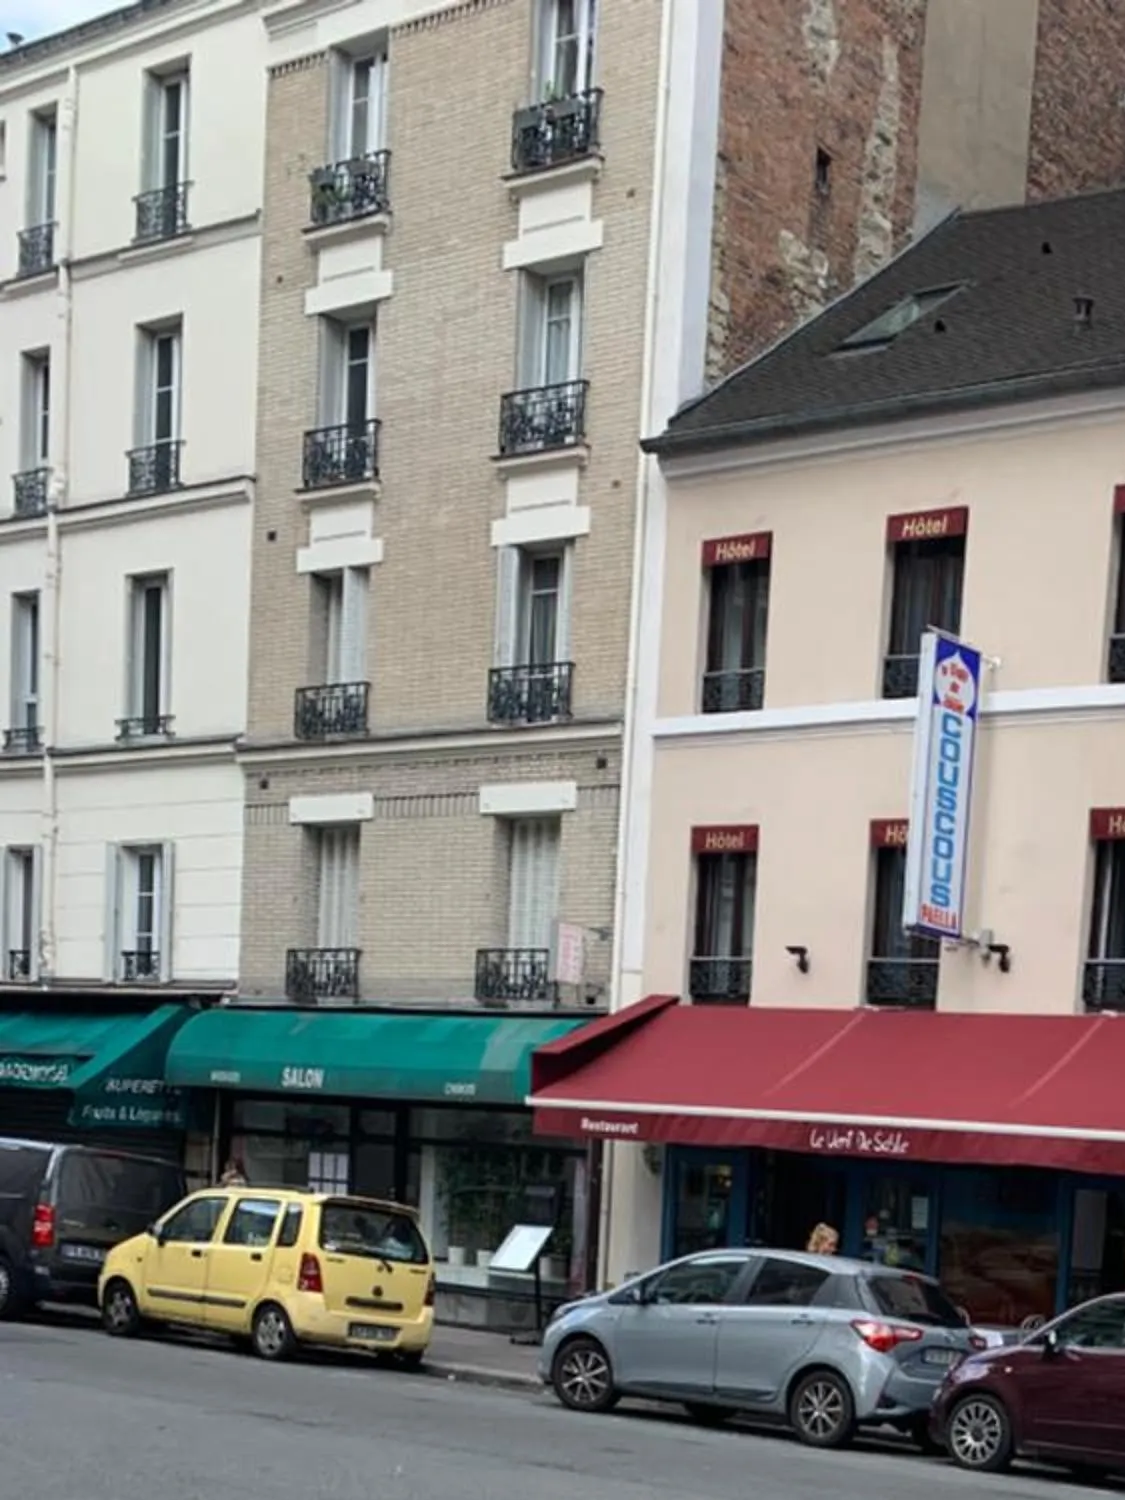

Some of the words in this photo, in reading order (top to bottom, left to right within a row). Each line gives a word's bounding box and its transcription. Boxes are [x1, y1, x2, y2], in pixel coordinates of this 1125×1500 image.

[901, 516, 948, 538] Hôtel
[715, 541, 755, 561] Hôtel
[930, 712, 963, 908] COUSCOUS
[705, 830, 744, 849] Hôtel
[281, 1066, 325, 1089] SALON
